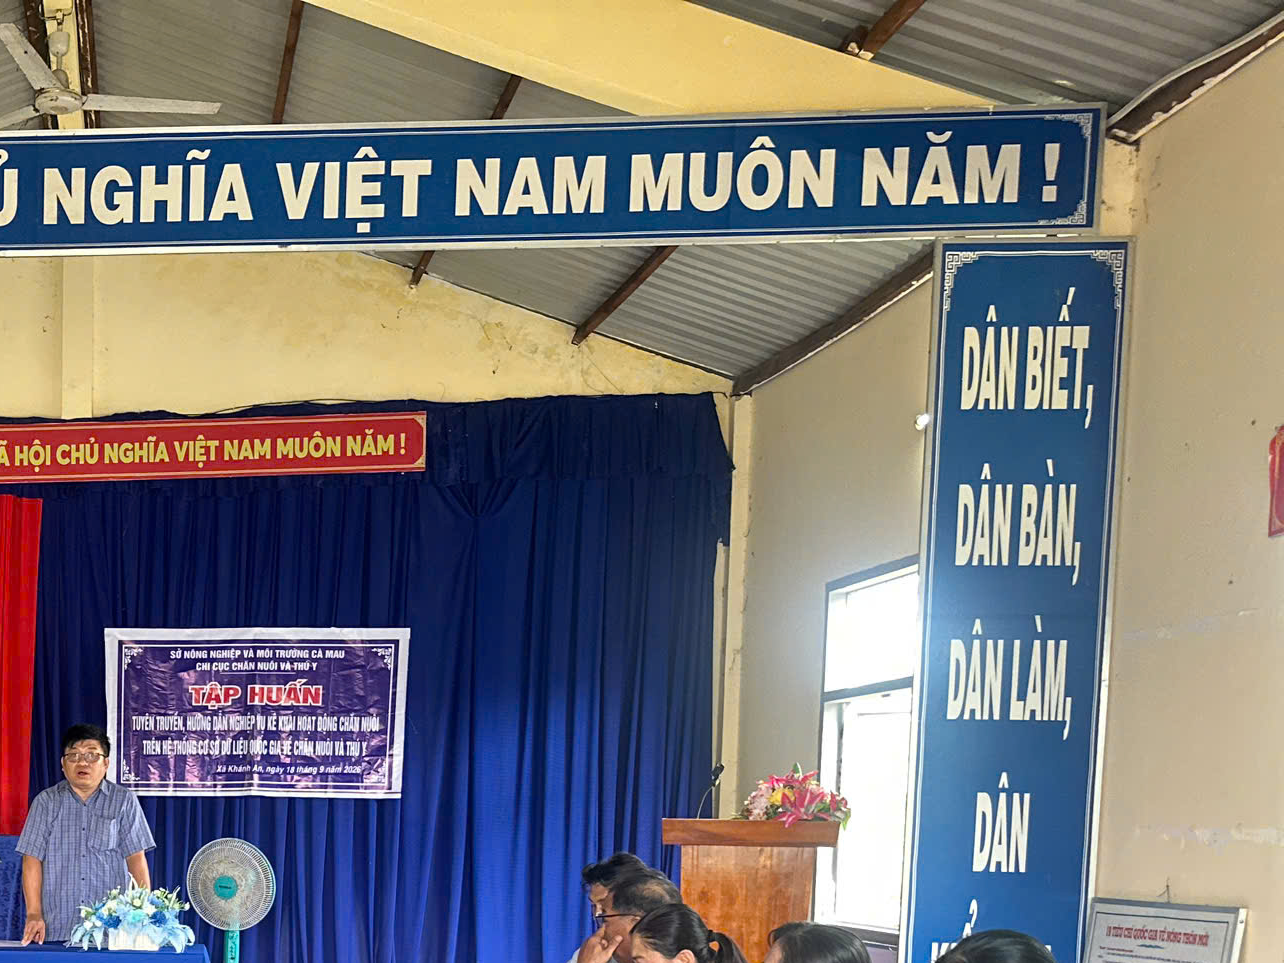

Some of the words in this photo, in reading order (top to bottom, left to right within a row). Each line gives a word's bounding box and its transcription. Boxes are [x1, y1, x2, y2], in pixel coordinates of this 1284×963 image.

[43, 148, 254, 225] NGHĨA
[275, 146, 431, 233] VIỆT
[455, 155, 607, 217] NAM
[629, 136, 836, 212] MUÔN
[861, 131, 1021, 207] NĂM
[1041, 142, 1061, 203] !
[960, 304, 1019, 410] DÂN
[1024, 286, 1094, 429] BIẾT,
[15, 439, 51, 473] HỘI
[56, 437, 100, 465] CHỦ
[103, 435, 170, 464] NGHĨA
[173, 434, 219, 469] VIỆT
[223, 438, 271, 460] NAM
[276, 431, 341, 459] MUÔN
[346, 428, 395, 457] NĂM
[400, 433, 406, 455] !
[955, 463, 1013, 566] DÂN
[1018, 458, 1081, 586] BÀN,
[170, 648, 182, 659] SỞ
[184, 649, 207, 659] NÔNG
[210, 649, 241, 660] NGHIỆP
[243, 648, 254, 658] VÀ
[256, 648, 273, 658] MÔI
[275, 648, 309, 658] TRƯỜNG
[311, 648, 323, 658] CÀ
[325, 650, 345, 658] MAU
[196, 662, 211, 671] CHI
[212, 662, 230, 672] CỤC
[232, 661, 255, 671] CHĂN
[257, 661, 278, 670] NUÔI
[280, 661, 291, 670] VÀ
[293, 660, 310, 671] THÚ
[311, 662, 318, 671] Y
[189, 682, 241, 709] TẬP
[247, 679, 322, 706] HUẤN
[946, 618, 1004, 721] DÂN
[1010, 615, 1072, 741] LÀM,
[132, 713, 155, 731] TUYÊN
[229, 712, 255, 733] NGHIỆP
[256, 715, 266, 734] VỤ
[267, 713, 276, 730] KÊ
[278, 715, 295, 731] KHAI
[297, 715, 316, 734] HOẠT
[317, 713, 337, 734] ĐỘNG
[339, 712, 360, 731] CHĂN
[361, 713, 380, 731] NUÔI
[143, 737, 161, 755] TRÊN
[162, 737, 172, 758] HỆ
[173, 735, 196, 755] THỐNG
[198, 738, 209, 755] CƠ
[221, 738, 232, 755] DỮ
[233, 737, 248, 758] LIỆU
[249, 735, 267, 755] QUỐC
[269, 740, 281, 755] GIA
[294, 738, 314, 755] CHĂN
[316, 738, 333, 755] NUÔI
[335, 738, 344, 756] VÀ
[362, 741, 368, 756] Y
[228, 765, 251, 773] Khánh
[252, 764, 264, 774] An,
[266, 766, 284, 774] ngày
[296, 765, 317, 774] tháng
[325, 765, 342, 773] năm
[972, 772, 1030, 873] DÂN
